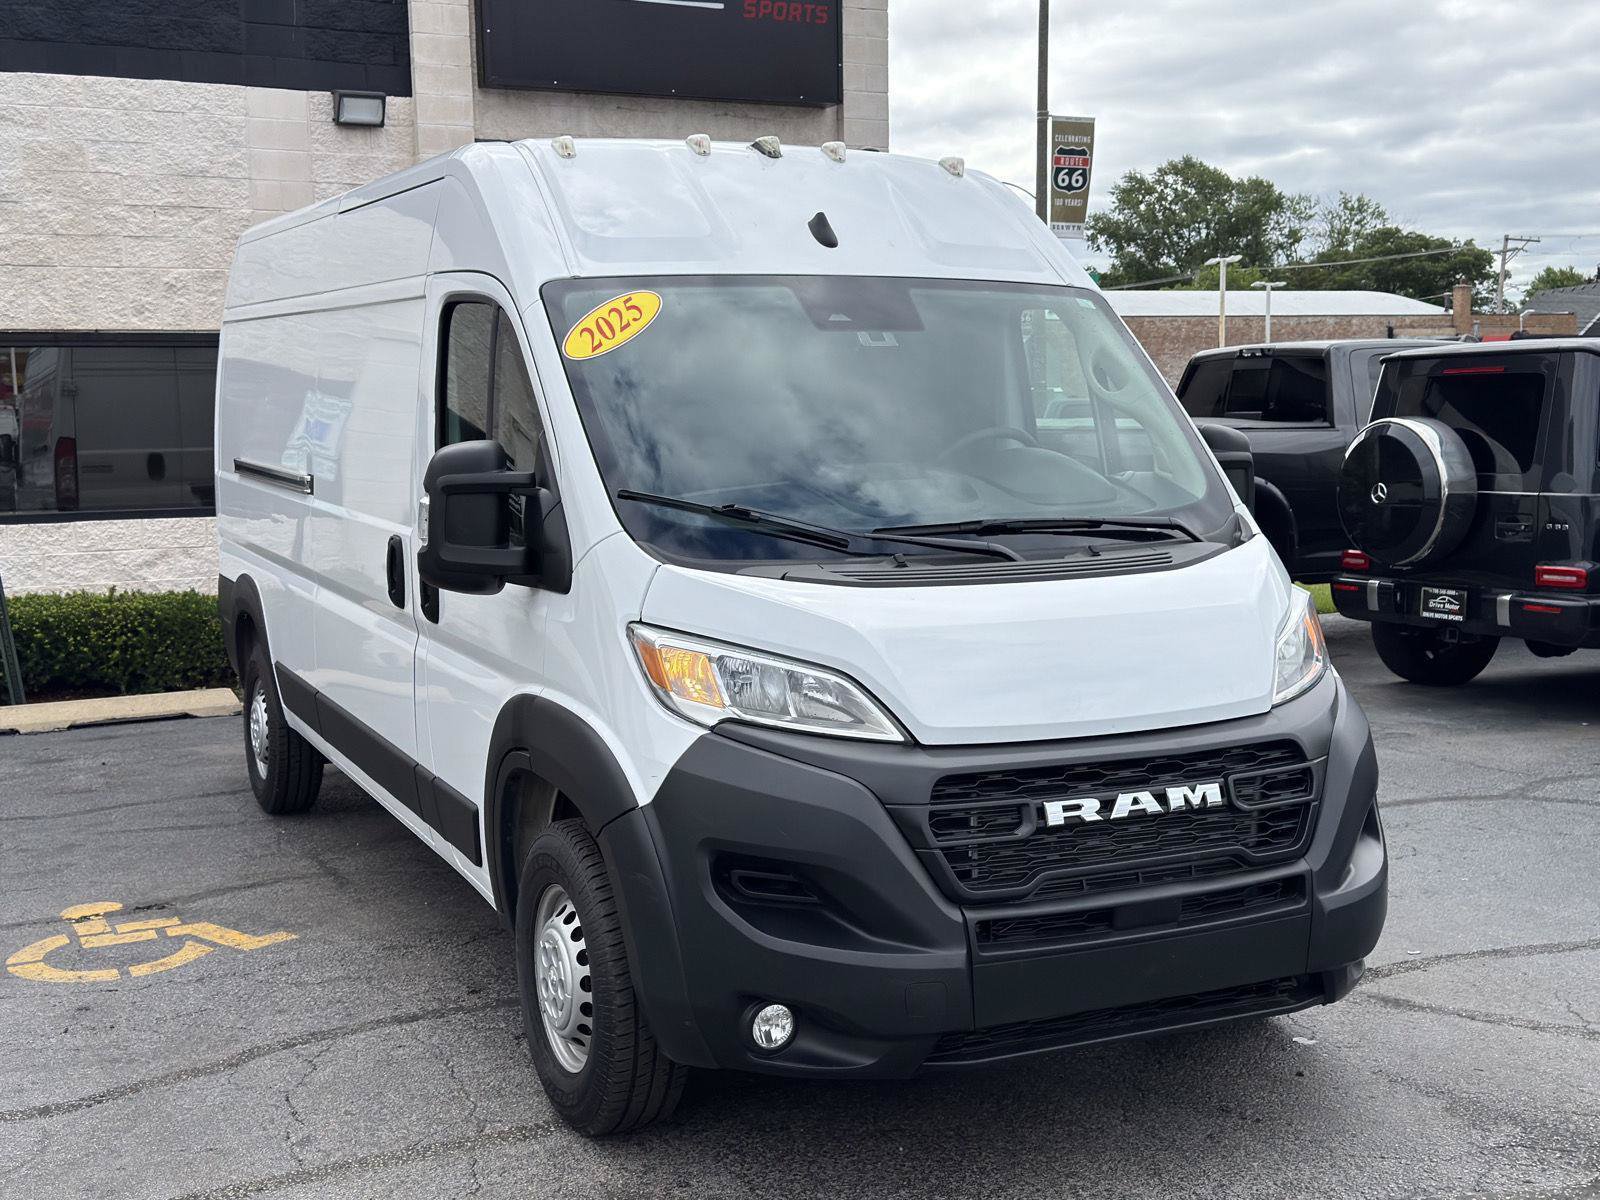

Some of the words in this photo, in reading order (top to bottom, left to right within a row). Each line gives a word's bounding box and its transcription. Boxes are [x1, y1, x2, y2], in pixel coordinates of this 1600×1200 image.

[743, 0, 828, 24] SPORTS
[1055, 134, 1091, 143] CELEBRATING
[1060, 157, 1084, 166] ROUTE
[1057, 168, 1084, 187] 66
[579, 296, 643, 353] 2025
[1043, 782, 1223, 827] RAM
